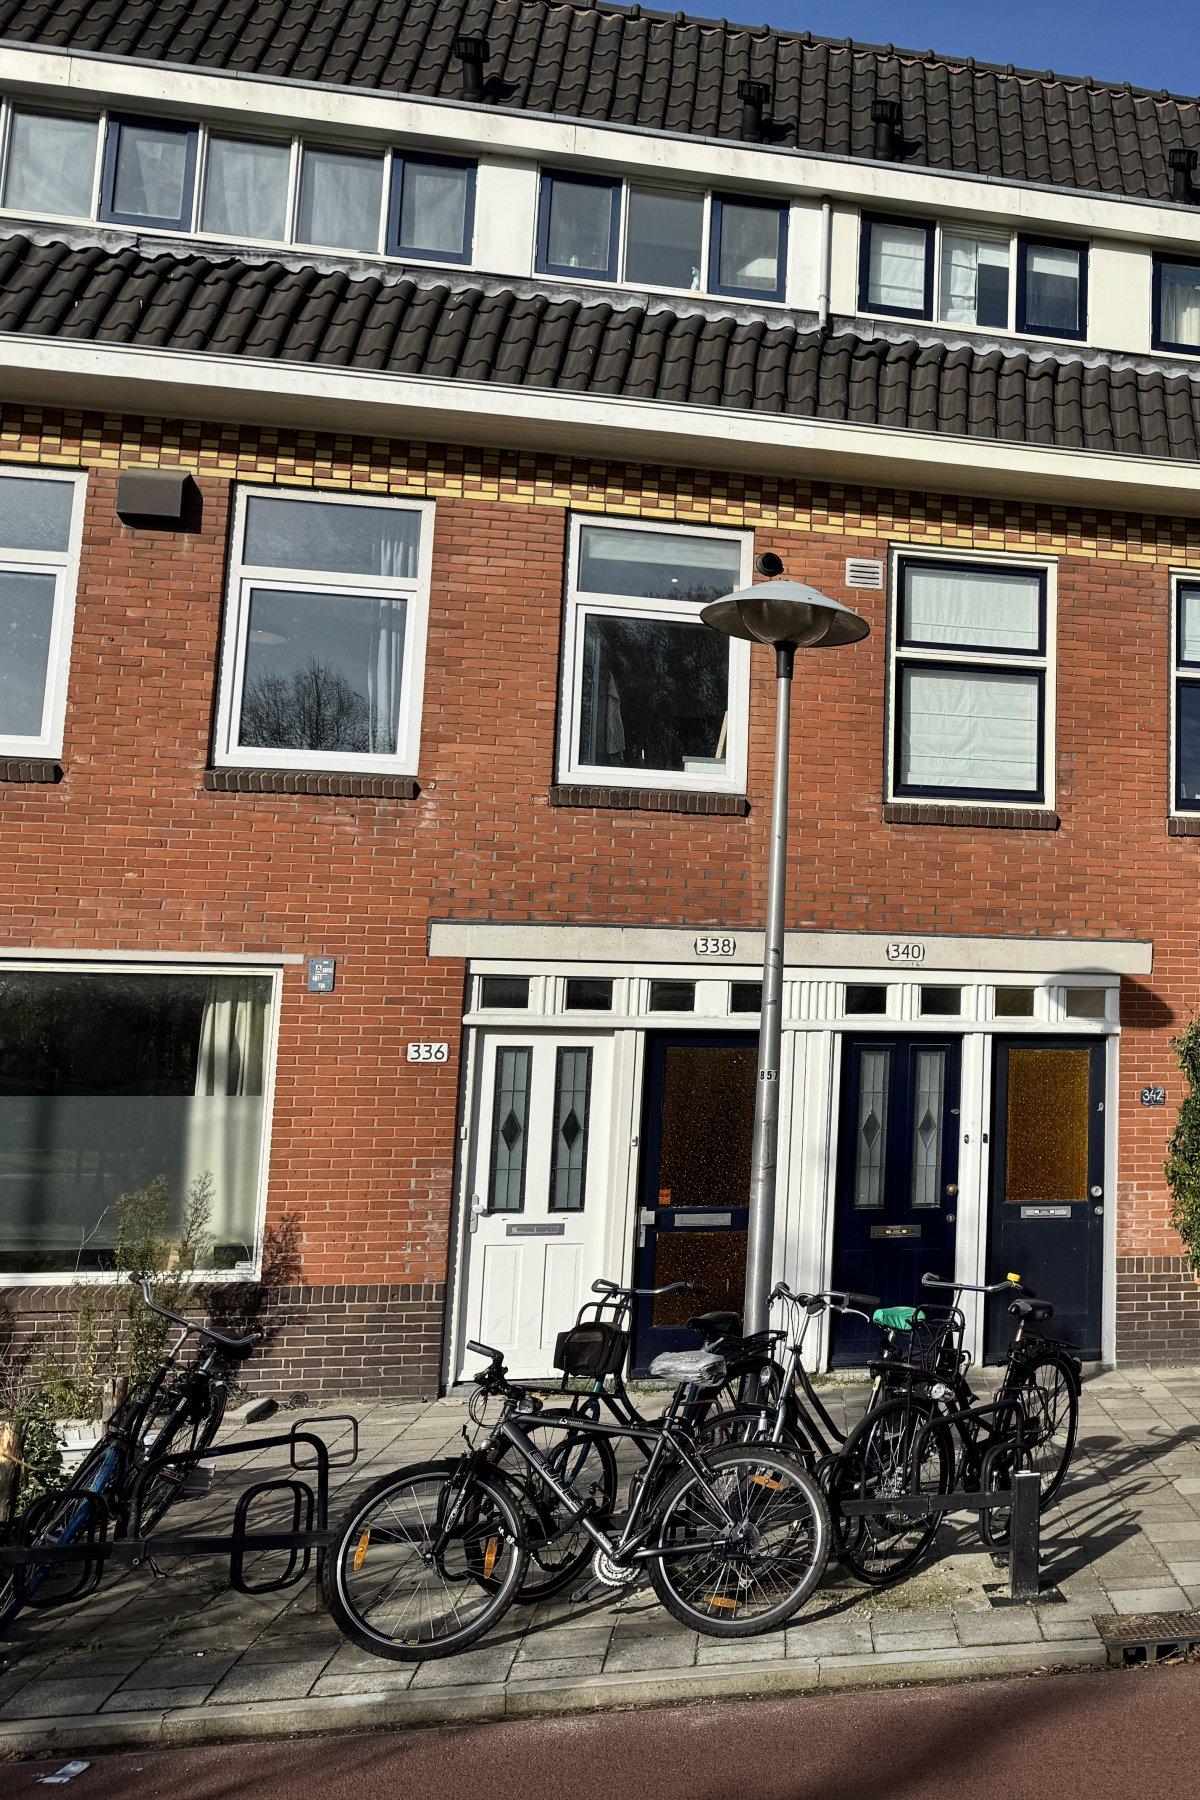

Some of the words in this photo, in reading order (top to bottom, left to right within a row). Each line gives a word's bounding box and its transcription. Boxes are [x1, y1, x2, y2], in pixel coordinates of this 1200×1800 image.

[699, 938, 731, 954] 338
[890, 944, 921, 959] 340
[410, 1044, 446, 1060] 336
[759, 1069, 779, 1081] 857
[1142, 1088, 1164, 1101] 342
